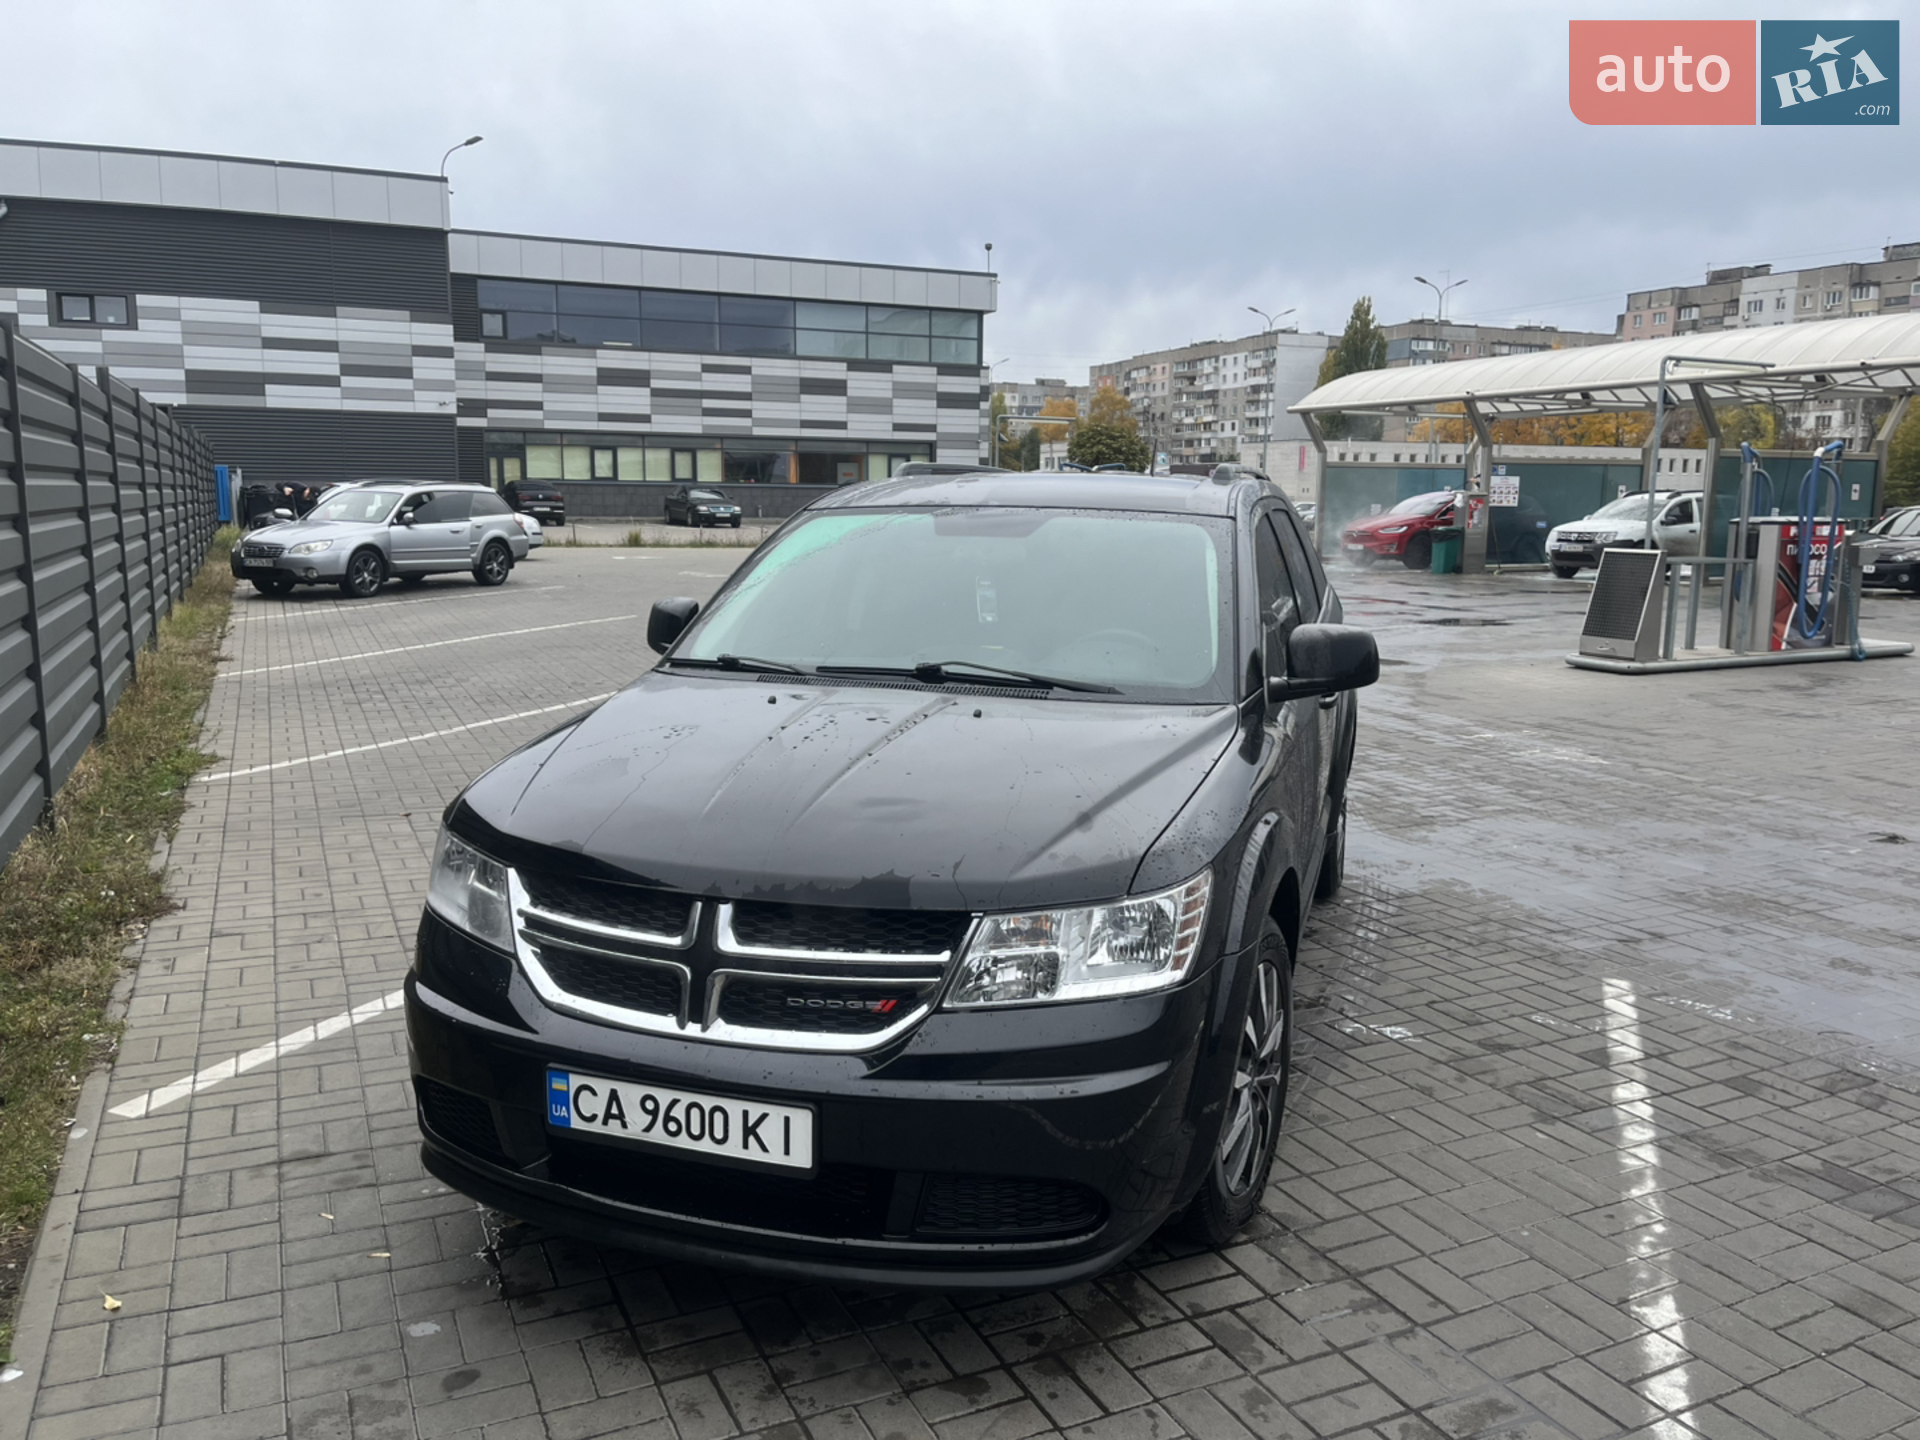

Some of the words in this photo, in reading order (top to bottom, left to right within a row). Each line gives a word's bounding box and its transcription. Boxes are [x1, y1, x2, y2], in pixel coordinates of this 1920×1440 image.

[786, 997, 882, 1010] DODGE
[552, 1104, 569, 1118] UA
[572, 1083, 629, 1130] CA
[639, 1093, 729, 1146] 9600
[742, 1108, 790, 1156] KI
